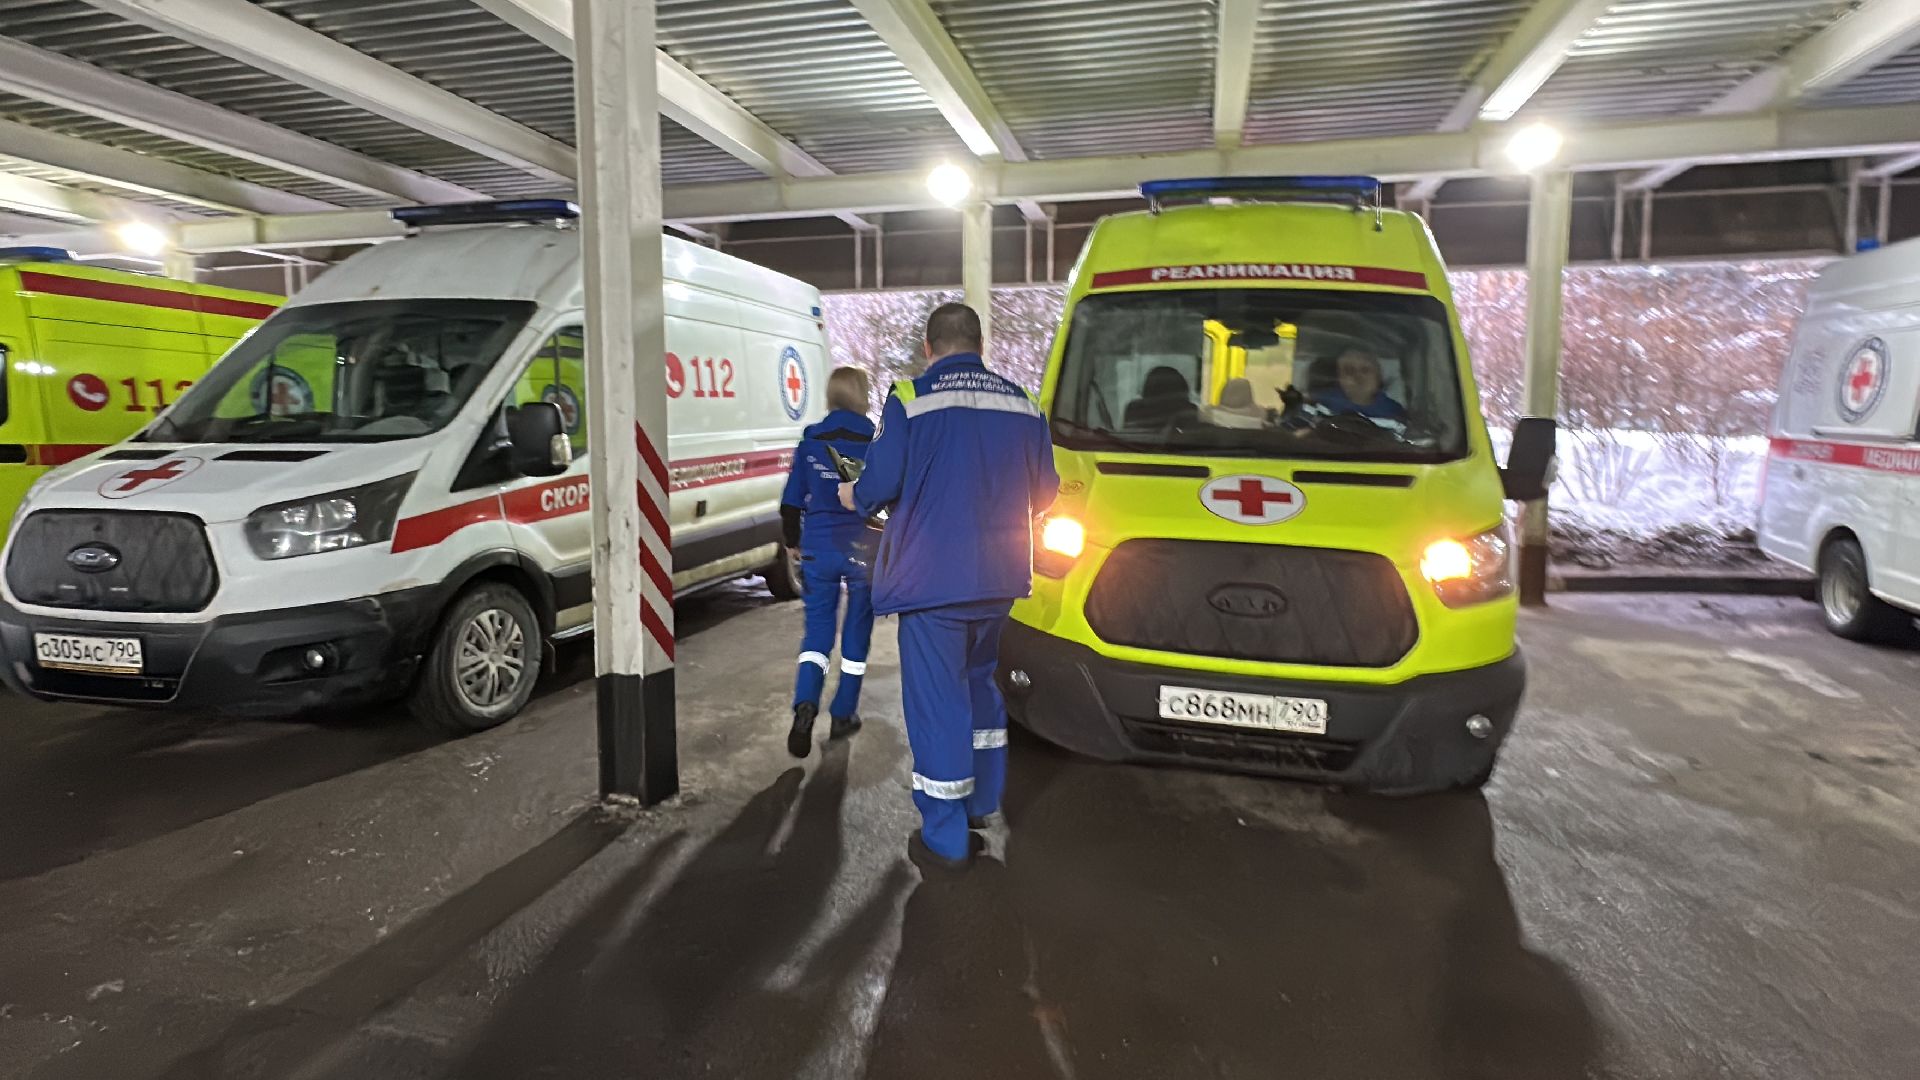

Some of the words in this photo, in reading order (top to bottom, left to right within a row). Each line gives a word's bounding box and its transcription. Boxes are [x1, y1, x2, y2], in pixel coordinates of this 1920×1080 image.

[1151, 264, 1355, 281] РЕАНИМАЦИЯ
[690, 356, 736, 398] 112
[541, 482, 589, 512] СКОР
[106, 641, 136, 657] 790
[1168, 693, 1272, 725] С868МН
[1275, 699, 1320, 722] 790
